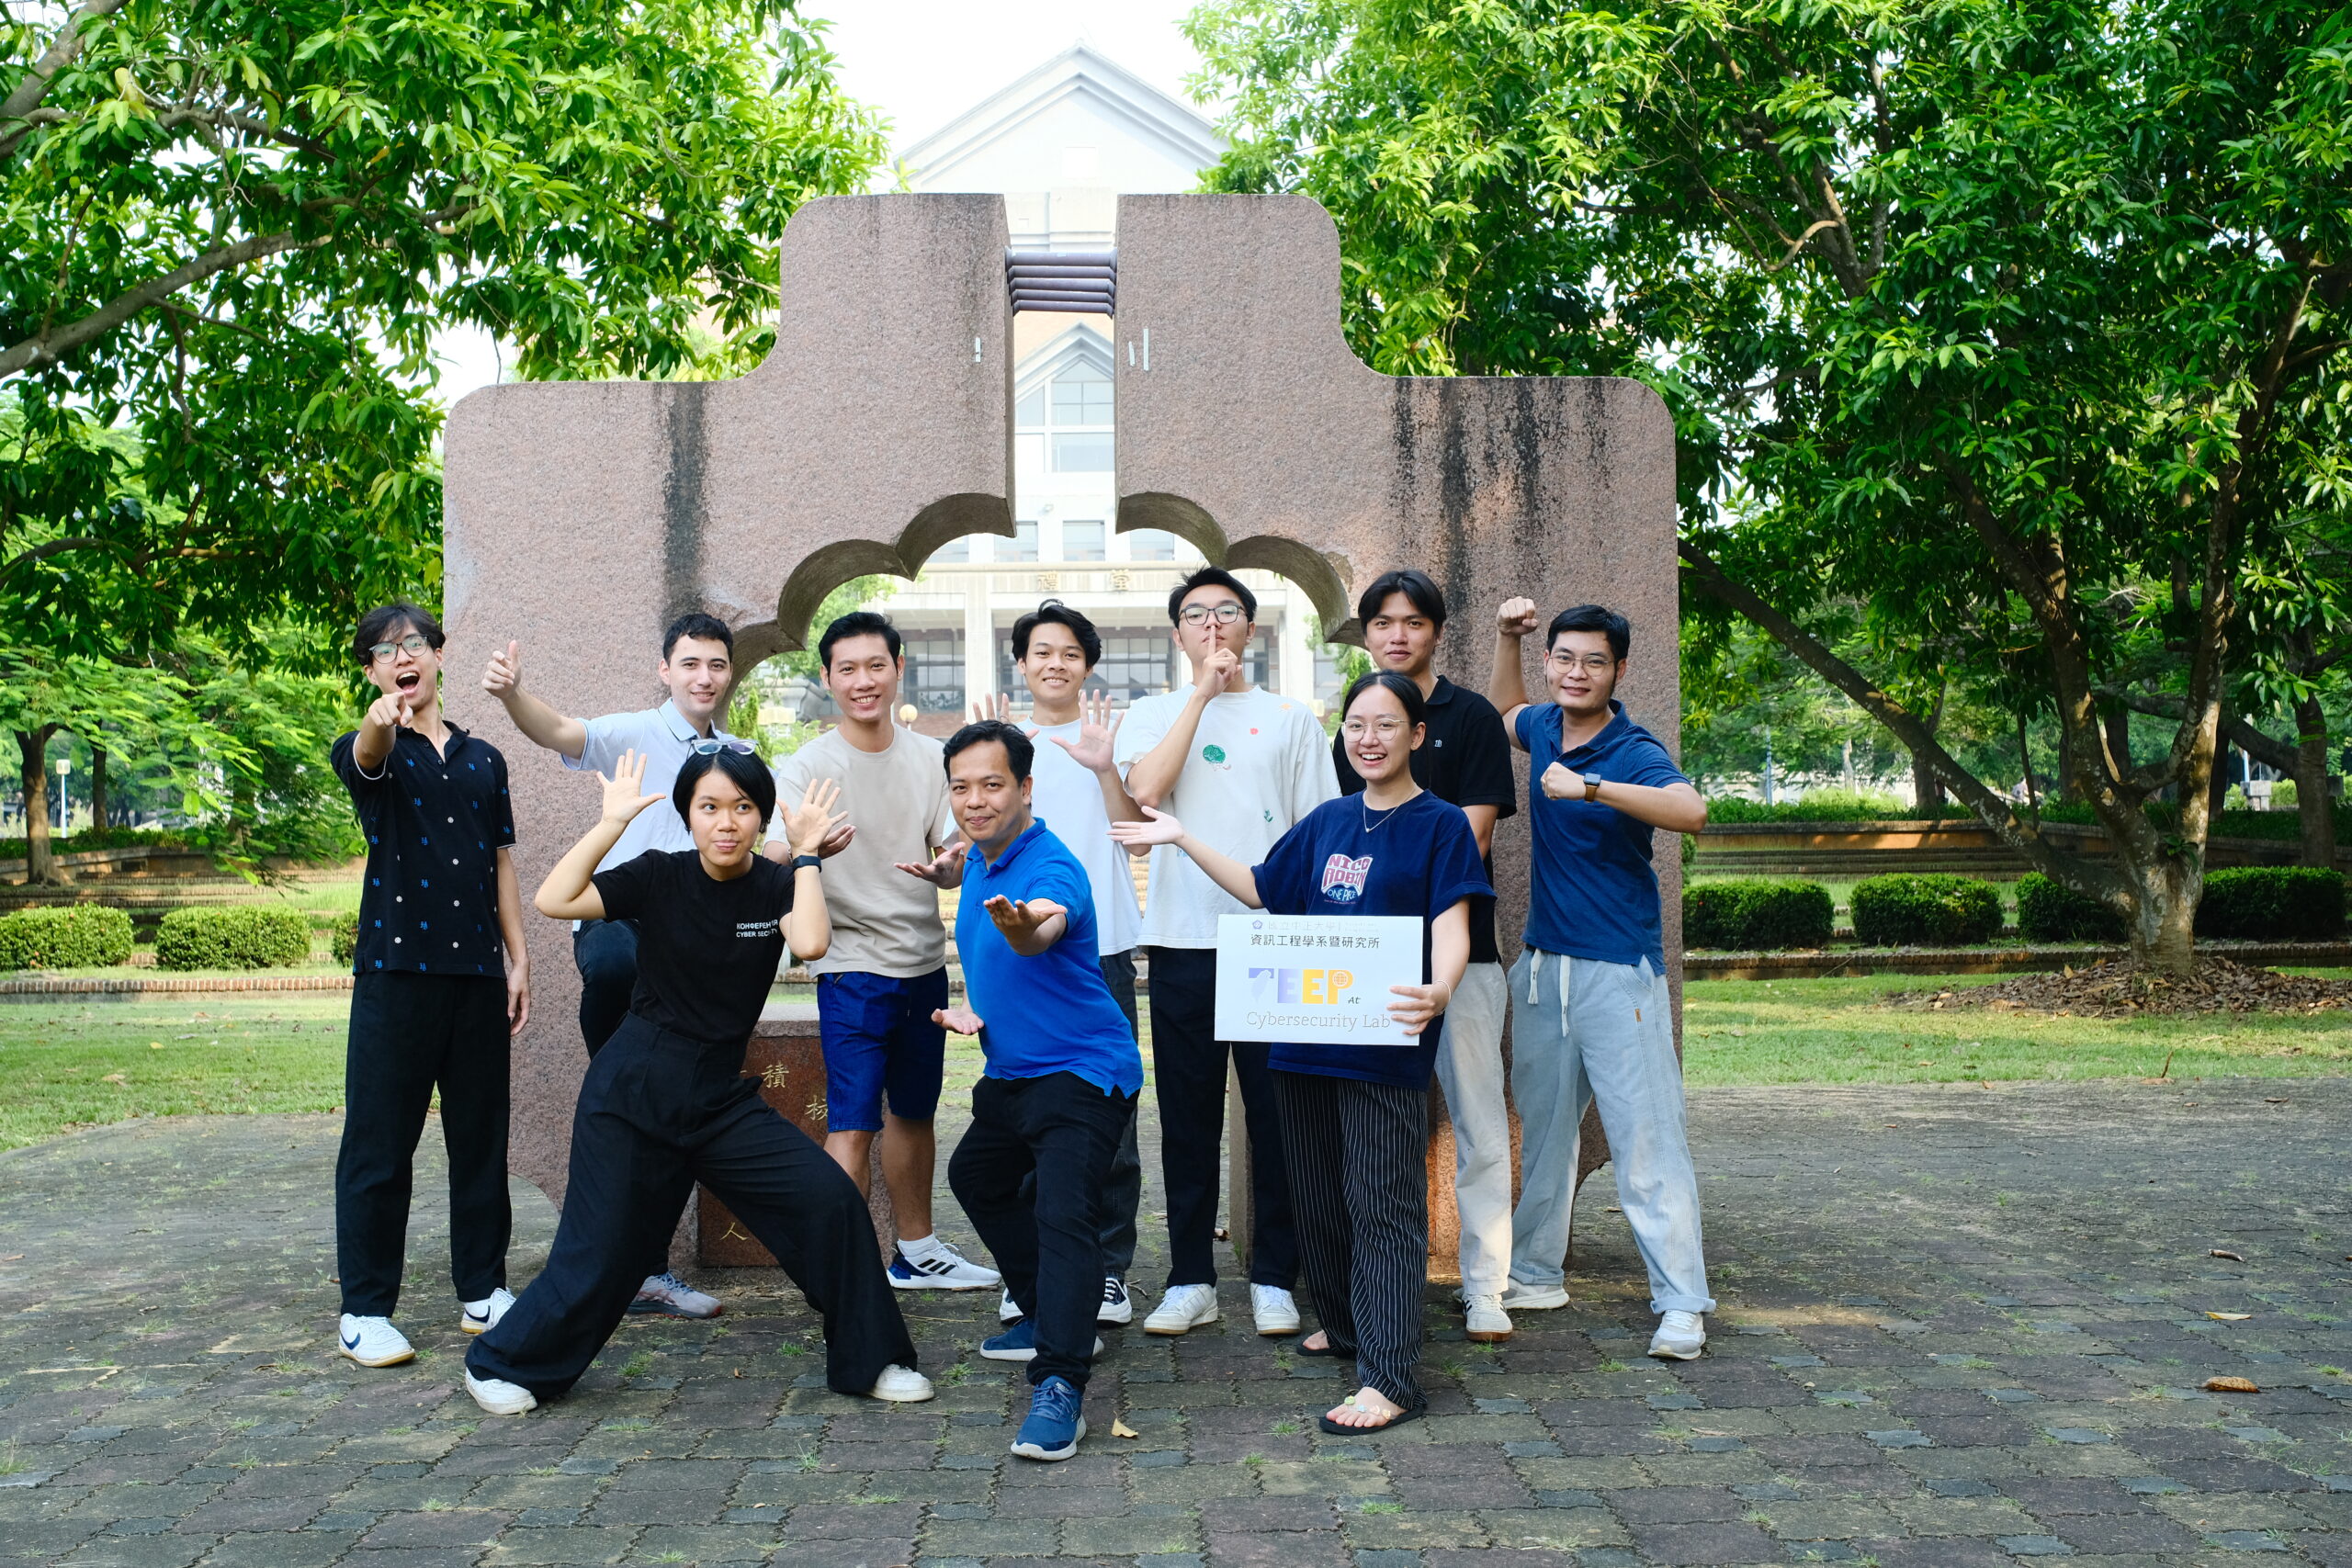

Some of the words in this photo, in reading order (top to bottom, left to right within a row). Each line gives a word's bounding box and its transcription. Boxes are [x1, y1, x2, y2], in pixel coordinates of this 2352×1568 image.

[1328, 855, 1371, 871] NICO
[1323, 867, 1367, 891] ROBIN
[1327, 888, 1342, 900] ONE
[1250, 933, 1380, 949] 資訊工程學系暨研究所
[1249, 967, 1353, 1005] TEEP
[1247, 1010, 1358, 1032] Cybersecurity
[1363, 1014, 1391, 1029] Lab
[720, 1222, 750, 1241] 人
